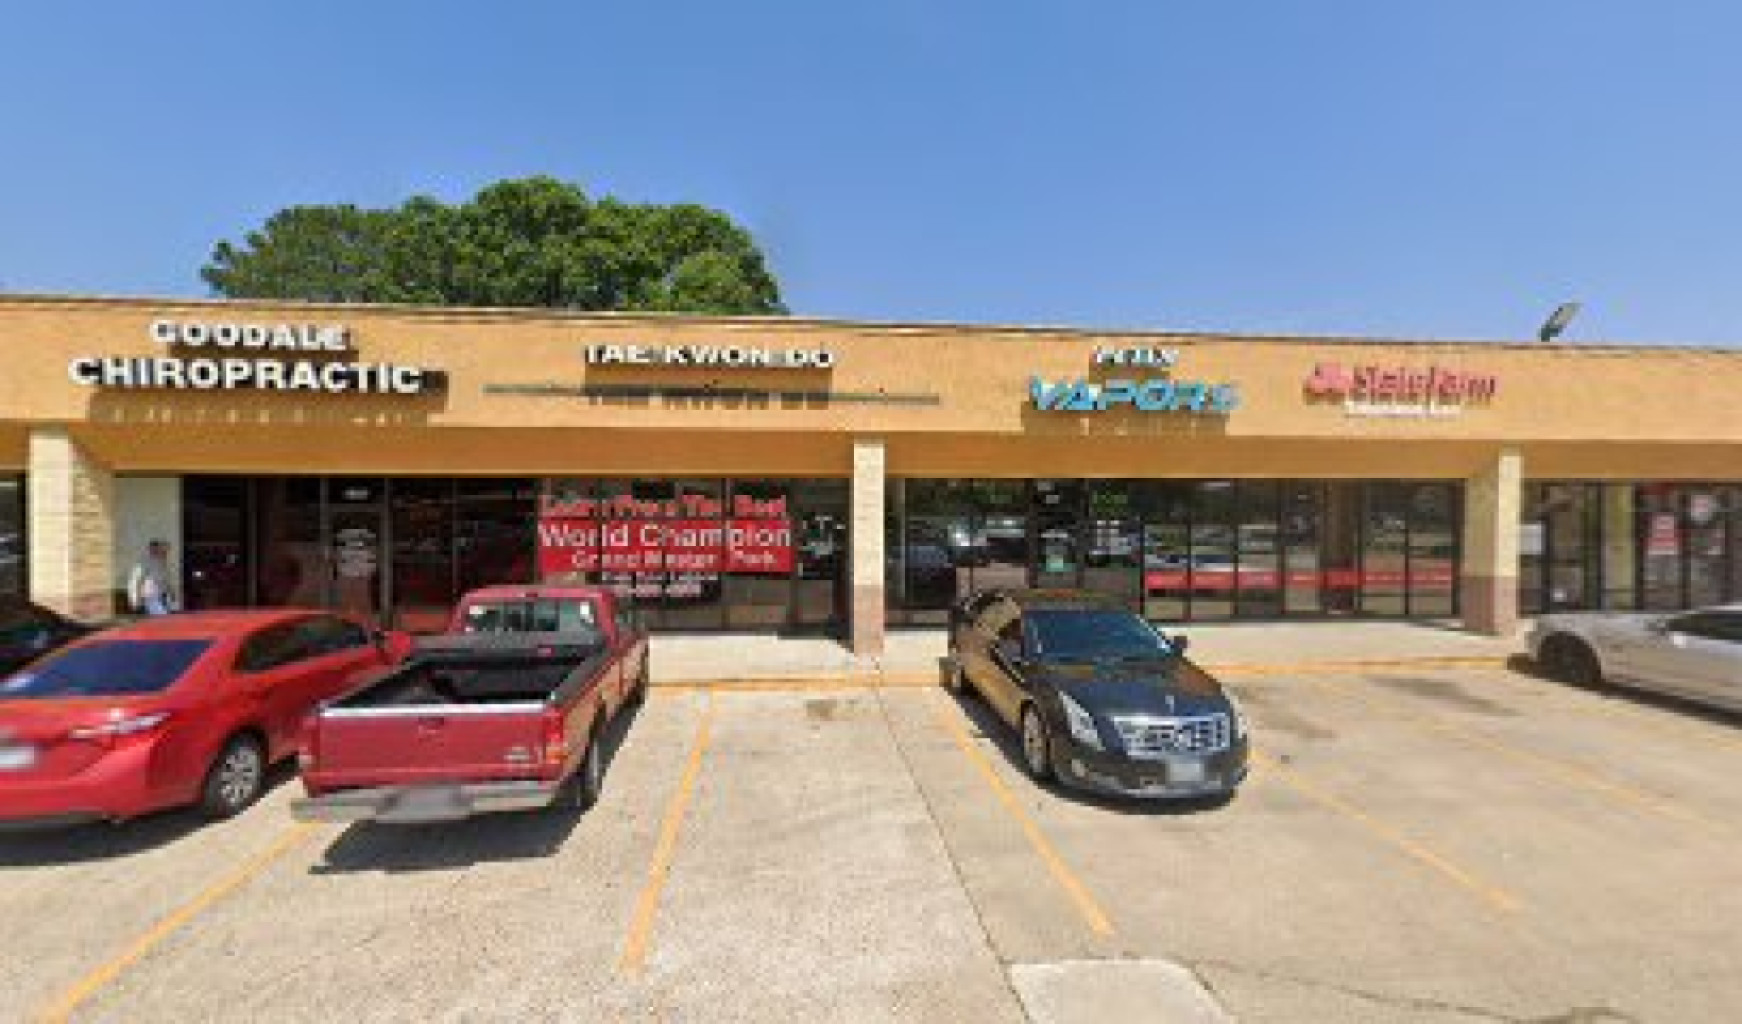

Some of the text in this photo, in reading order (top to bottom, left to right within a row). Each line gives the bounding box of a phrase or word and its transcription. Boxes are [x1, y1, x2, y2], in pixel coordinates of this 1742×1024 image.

[152, 319, 348, 350] GOODALE
[585, 344, 834, 368] TAE KWON DO
[67, 357, 423, 394] CHIROPRACTIC
[1029, 377, 1239, 411] VAPORS
[538, 522, 792, 551] World Champion
